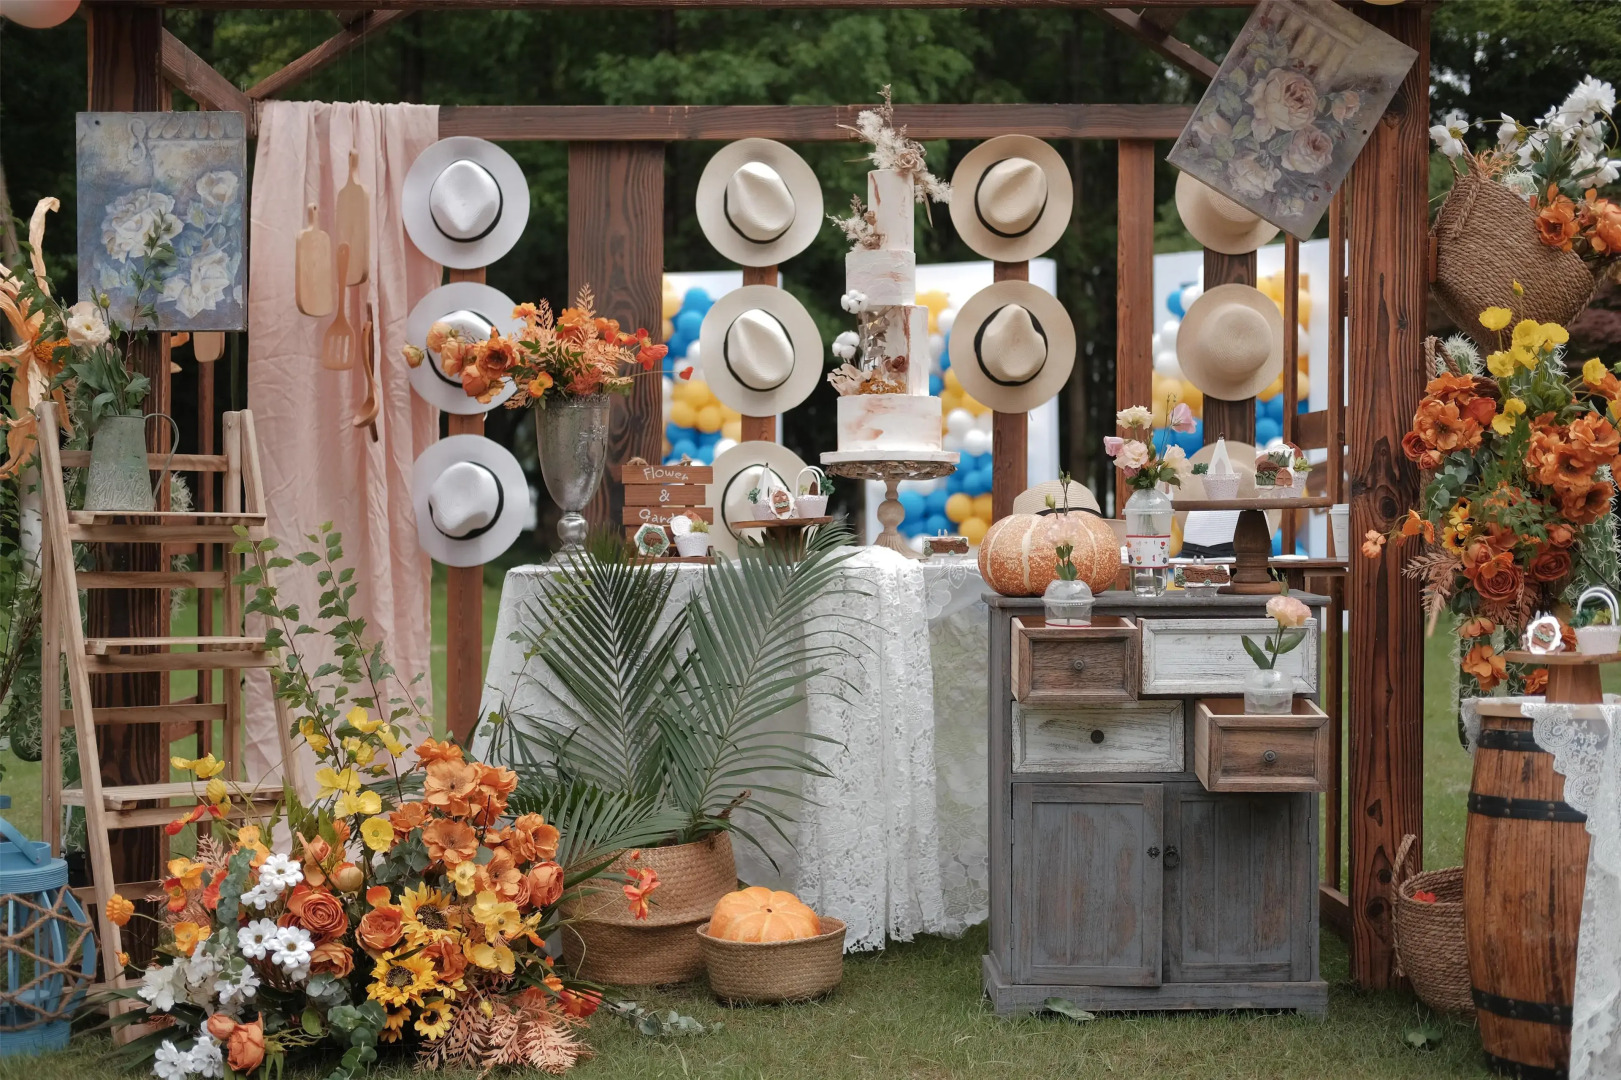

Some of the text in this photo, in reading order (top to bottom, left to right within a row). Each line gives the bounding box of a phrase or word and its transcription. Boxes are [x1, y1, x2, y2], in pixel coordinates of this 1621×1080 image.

[643, 466, 689, 481] Flower
[659, 489, 670, 502] &
[639, 508, 675, 524] Gard
